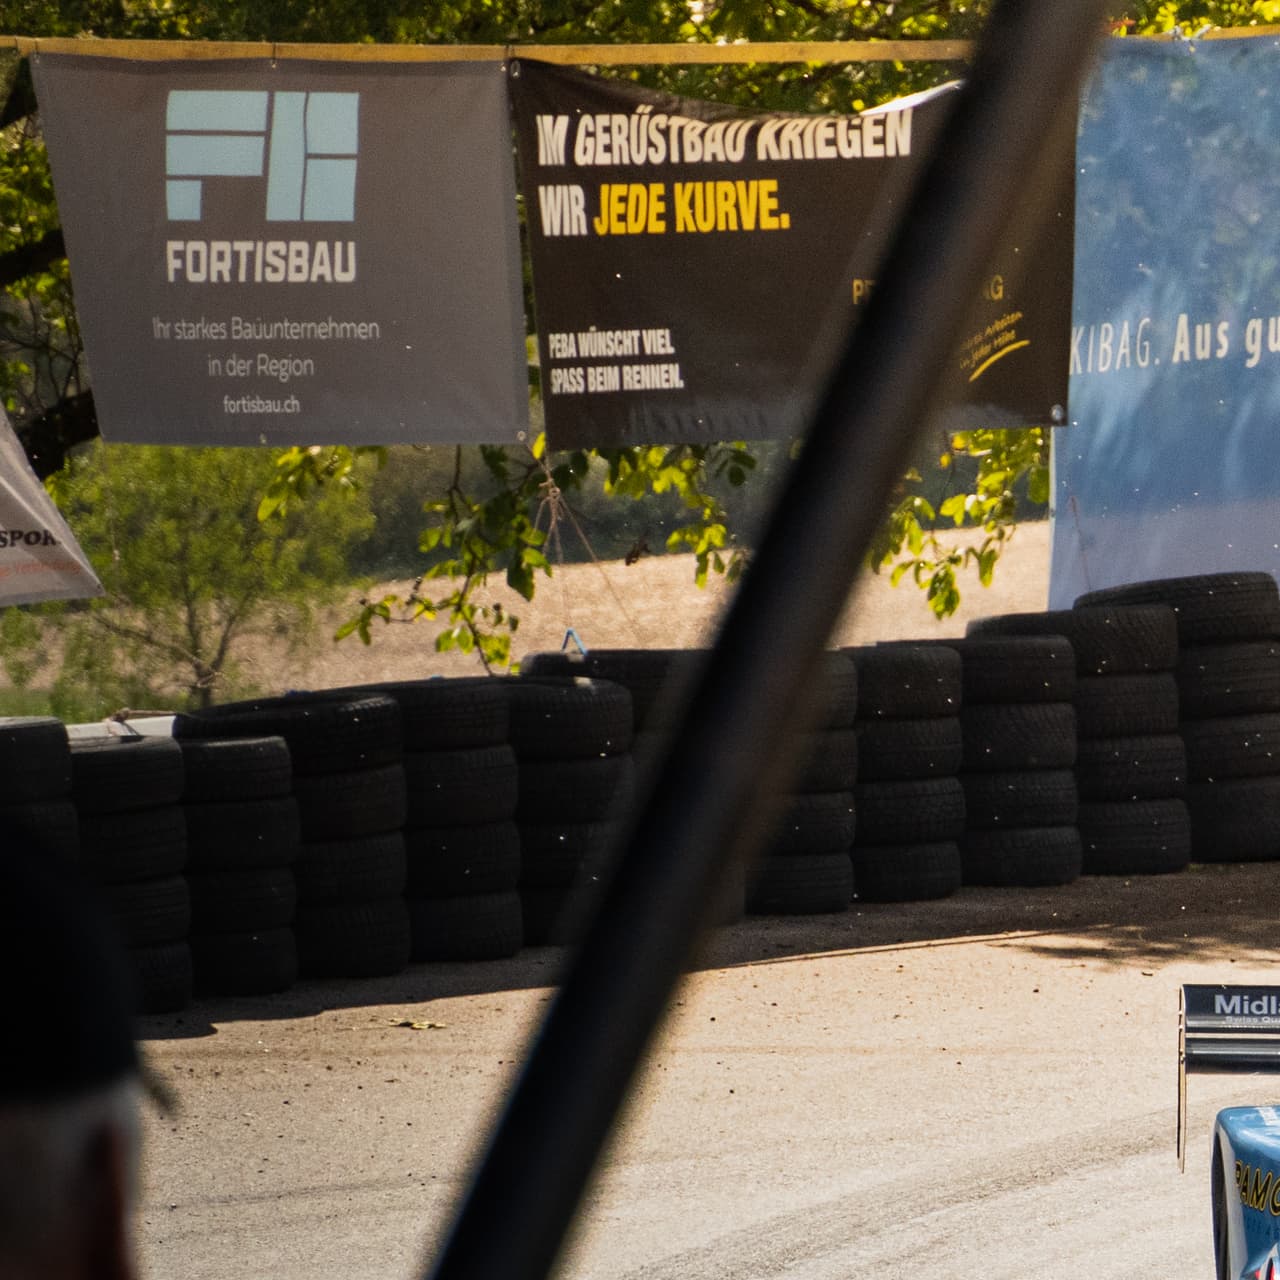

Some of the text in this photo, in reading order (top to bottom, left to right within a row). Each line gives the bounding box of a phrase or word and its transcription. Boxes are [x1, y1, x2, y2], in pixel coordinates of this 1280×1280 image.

[536, 104, 914, 166] IM GERÜSTBAU KRIEGEN
[538, 179, 791, 237] WIR JEDE KURVE.
[167, 240, 356, 283] FORTISBAU
[152, 317, 172, 339] Ihr
[174, 317, 228, 340] starkes
[548, 325, 675, 359] PEBA WÜNSCHT VIEL
[1069, 318, 1161, 376] KIBAG.
[1172, 313, 1230, 363] Aus
[208, 353, 315, 383] in der Region
[551, 363, 684, 395] SPASS BEIM RENNEN.
[223, 395, 301, 413] fortisbau.ch
